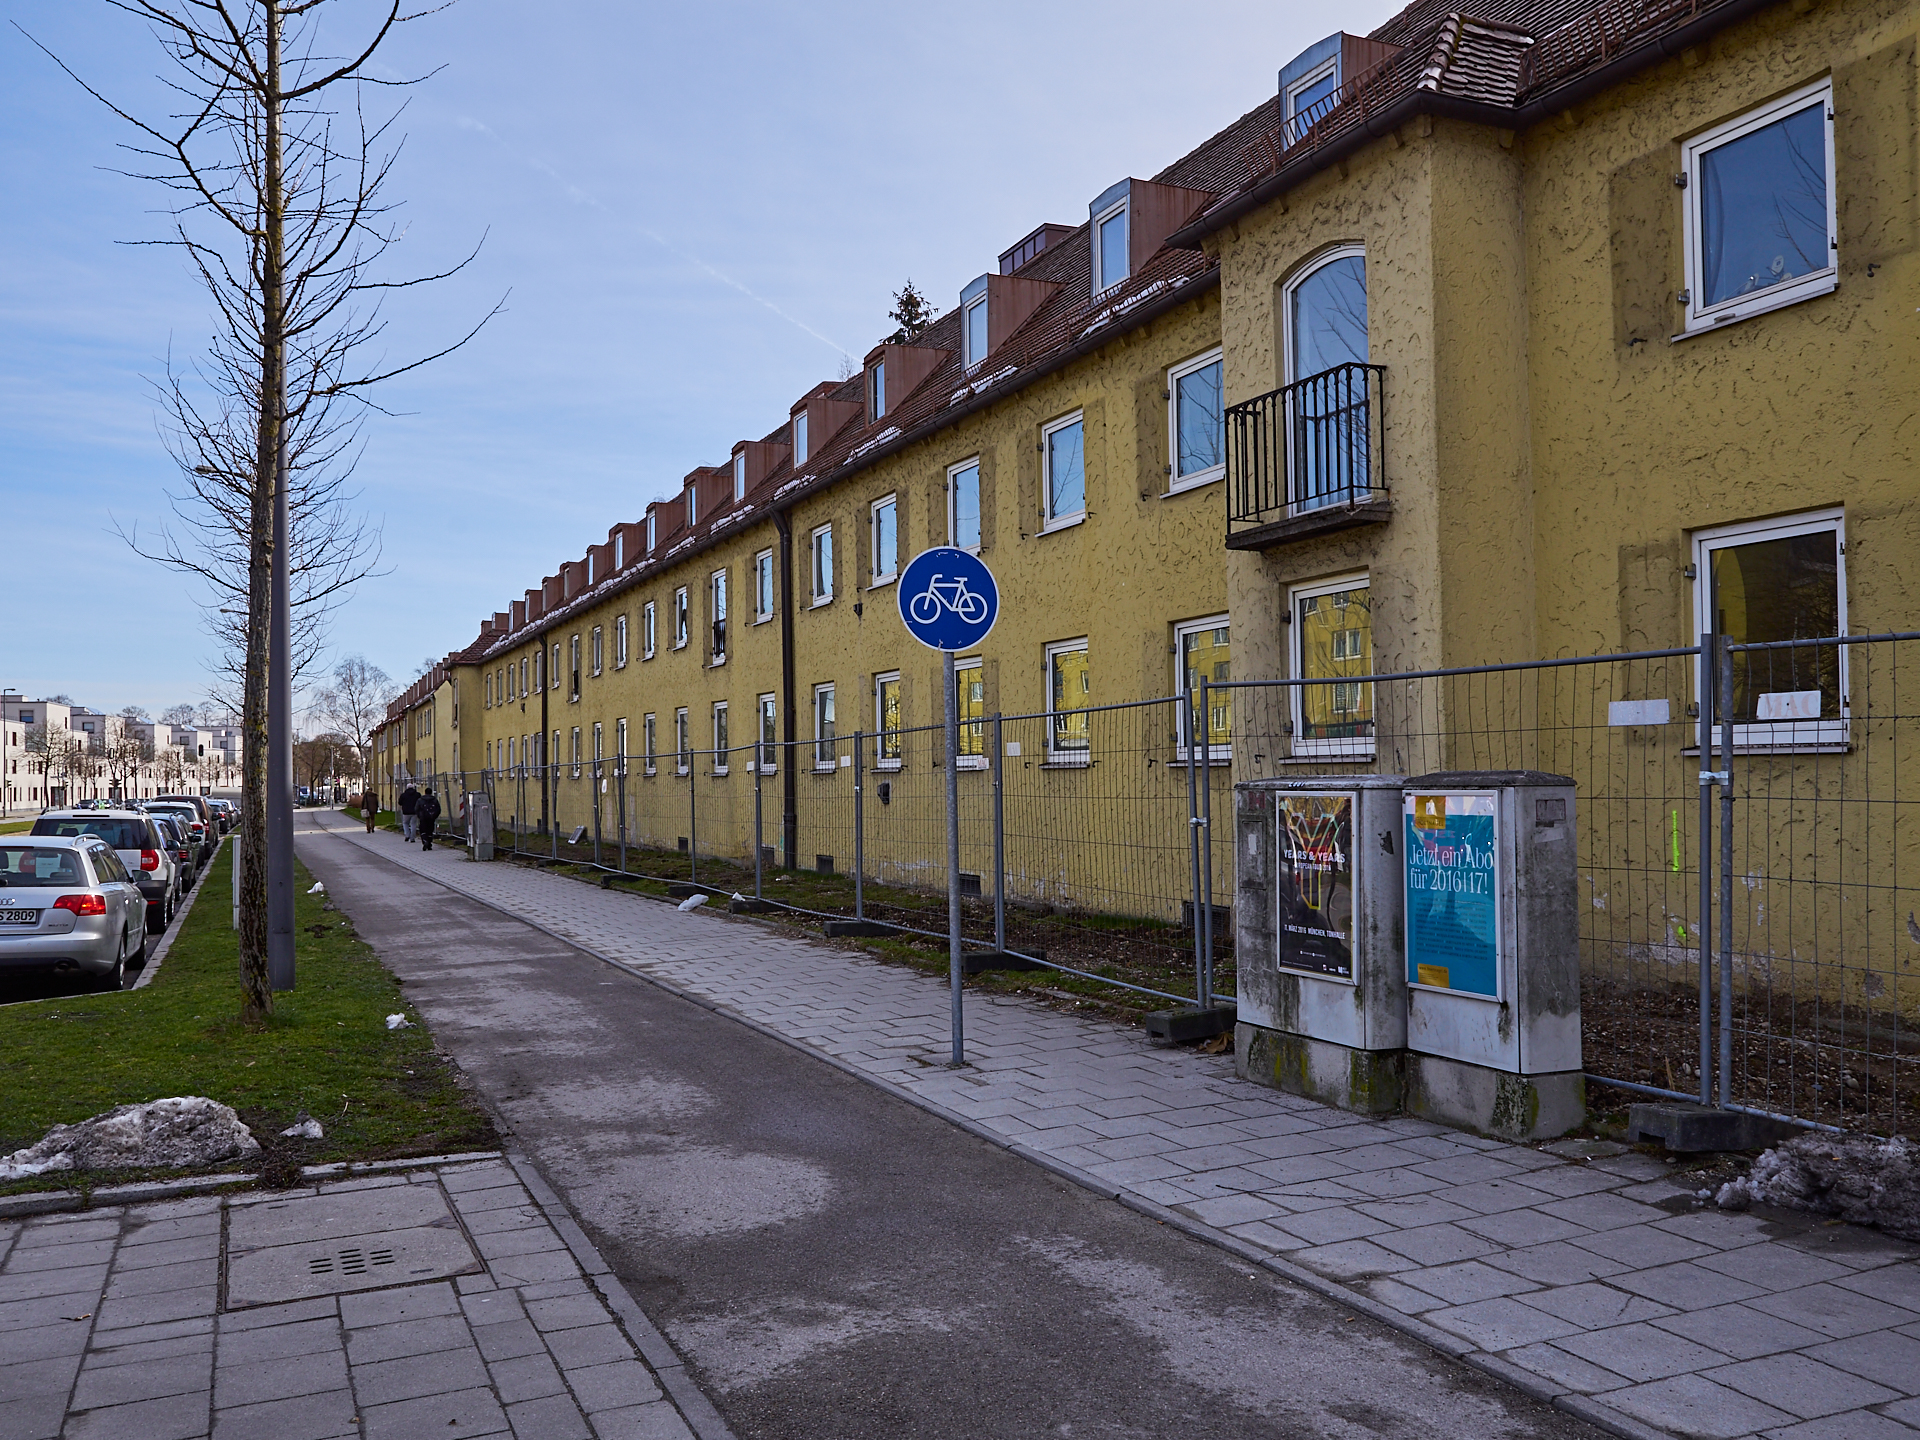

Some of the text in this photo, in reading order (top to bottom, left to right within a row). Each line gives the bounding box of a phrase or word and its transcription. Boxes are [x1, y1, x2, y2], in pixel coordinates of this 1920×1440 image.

[1284, 849, 1346, 863] YEARS & YEARS
[1410, 845, 1493, 869] Jetzt ein Abo
[1410, 868, 1428, 889] für
[6, 911, 35, 921] 2809
